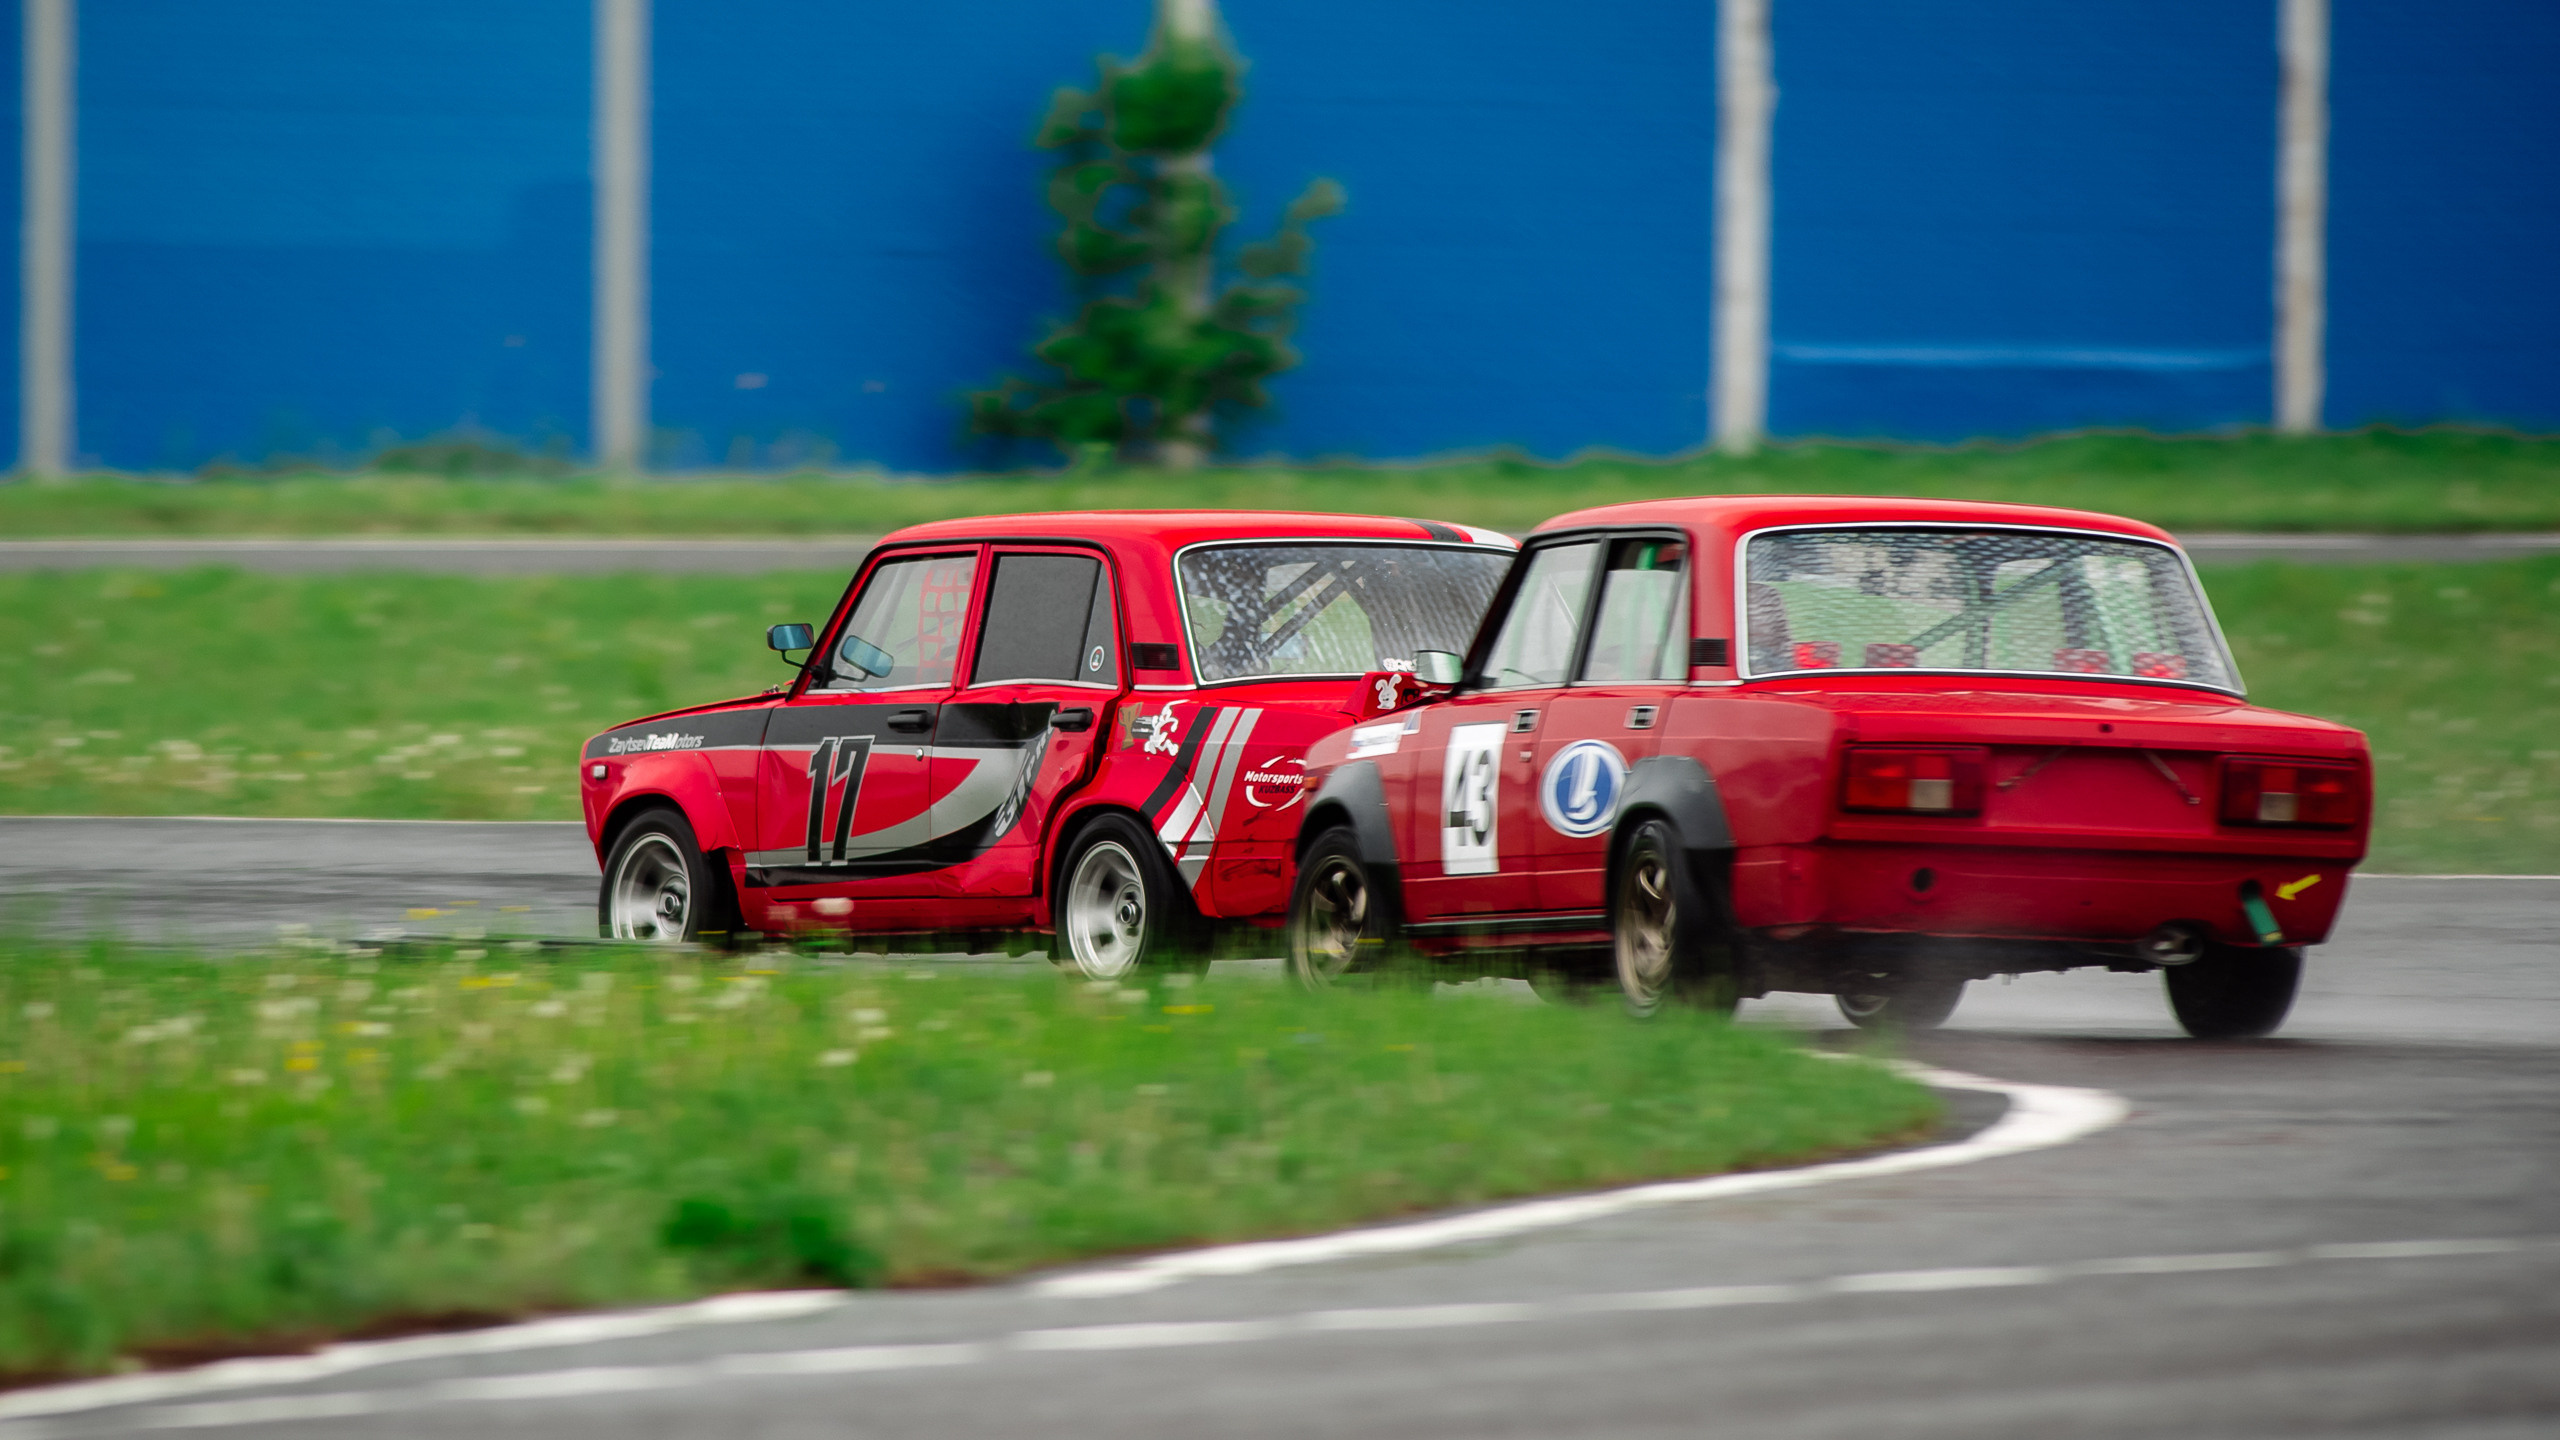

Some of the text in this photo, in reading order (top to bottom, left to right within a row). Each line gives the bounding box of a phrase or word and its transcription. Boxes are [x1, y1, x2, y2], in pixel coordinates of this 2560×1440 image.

[805, 734, 876, 867] 17
[1244, 770, 1304, 785] Motorsports
[1258, 785, 1297, 794] KUZBASS
[1443, 748, 1498, 847] 43
